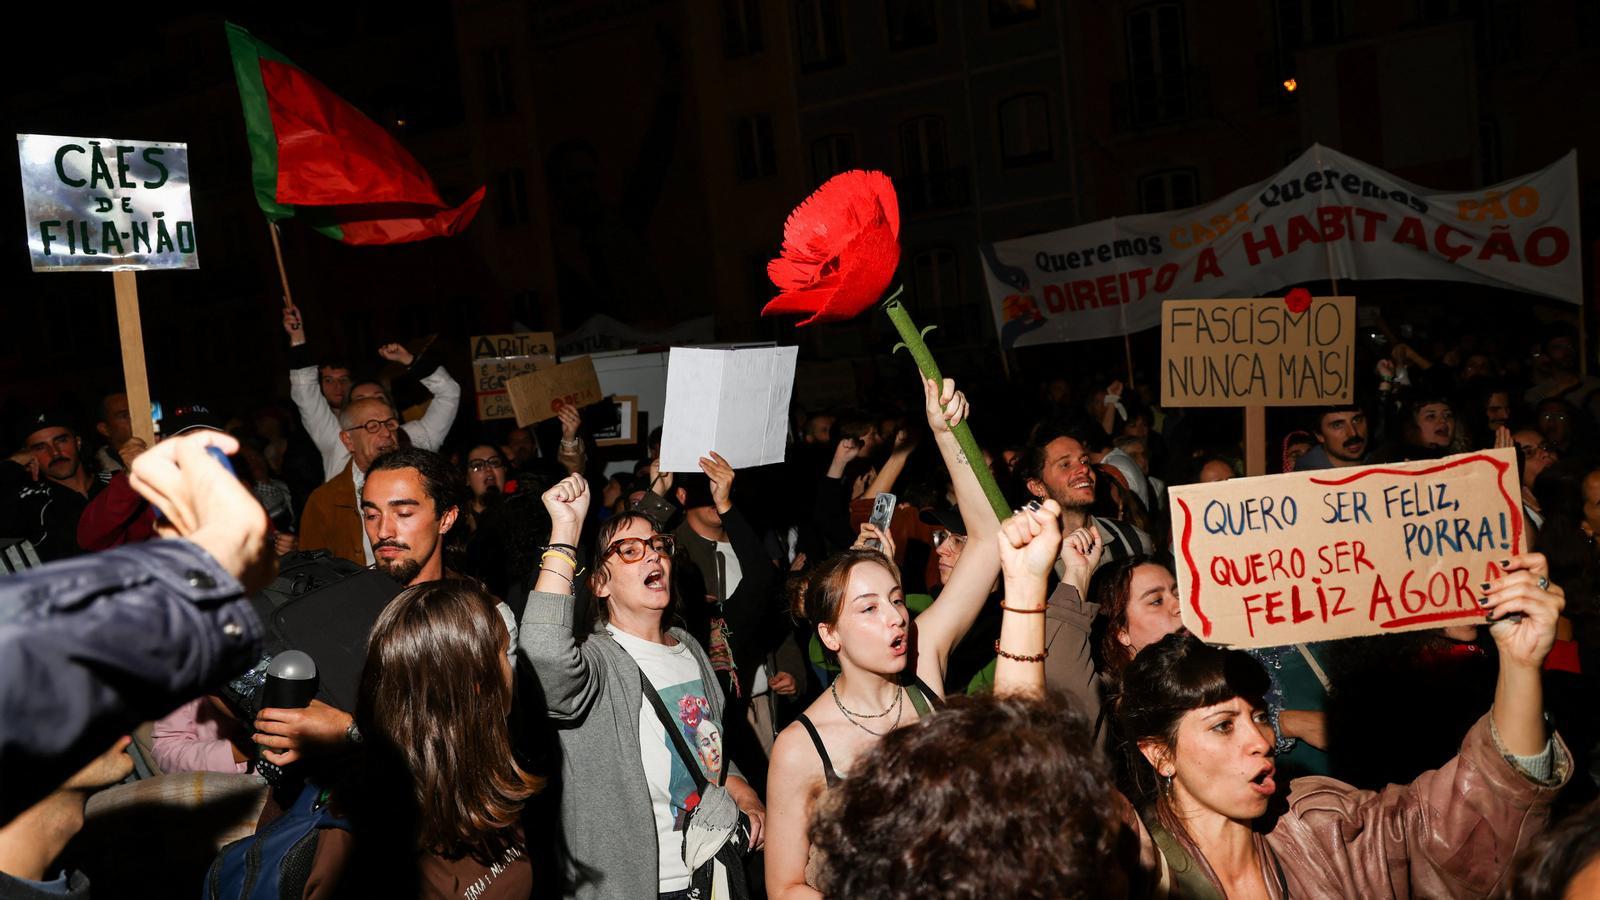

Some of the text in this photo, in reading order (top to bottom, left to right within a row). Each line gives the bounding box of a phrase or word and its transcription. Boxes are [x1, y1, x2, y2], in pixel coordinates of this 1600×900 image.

[54, 141, 169, 189] CÃES
[94, 197, 134, 213] DE
[1035, 236, 1163, 273] Queremos
[1456, 186, 1541, 221] PÃO
[40, 211, 196, 256] FILA-NÃO
[1042, 205, 1571, 315] DIREITO A HABITAÇÃO
[1168, 345, 1350, 400] NUNCA MAIS!
[1203, 481, 1460, 536] QUERO SER FELIZ,
[1403, 512, 1511, 562] PORRA!
[1210, 541, 1375, 587] QUERO SER
